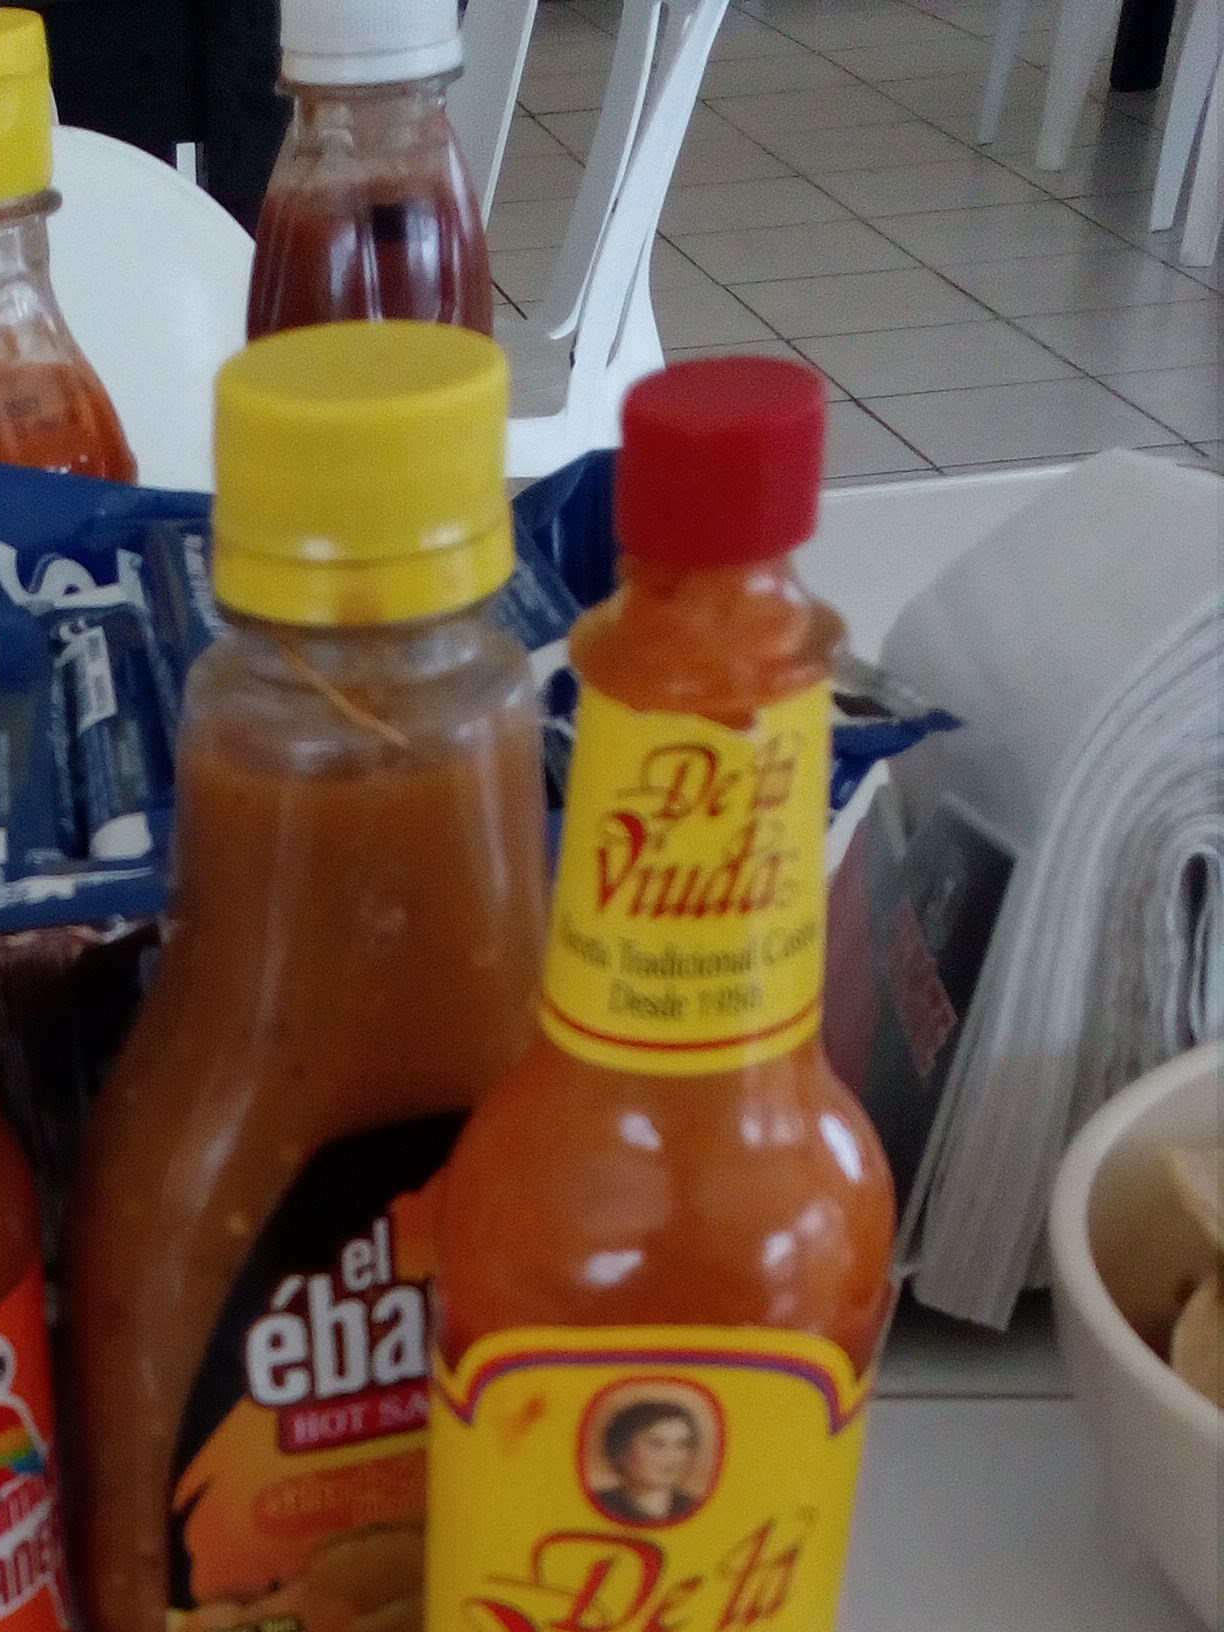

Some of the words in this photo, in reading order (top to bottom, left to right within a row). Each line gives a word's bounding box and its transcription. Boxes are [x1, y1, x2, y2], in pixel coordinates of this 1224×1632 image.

[595, 809, 798, 920] Viuda
[340, 1216, 393, 1292] el
[243, 1273, 427, 1406] éba
[293, 1405, 367, 1445] HOT
